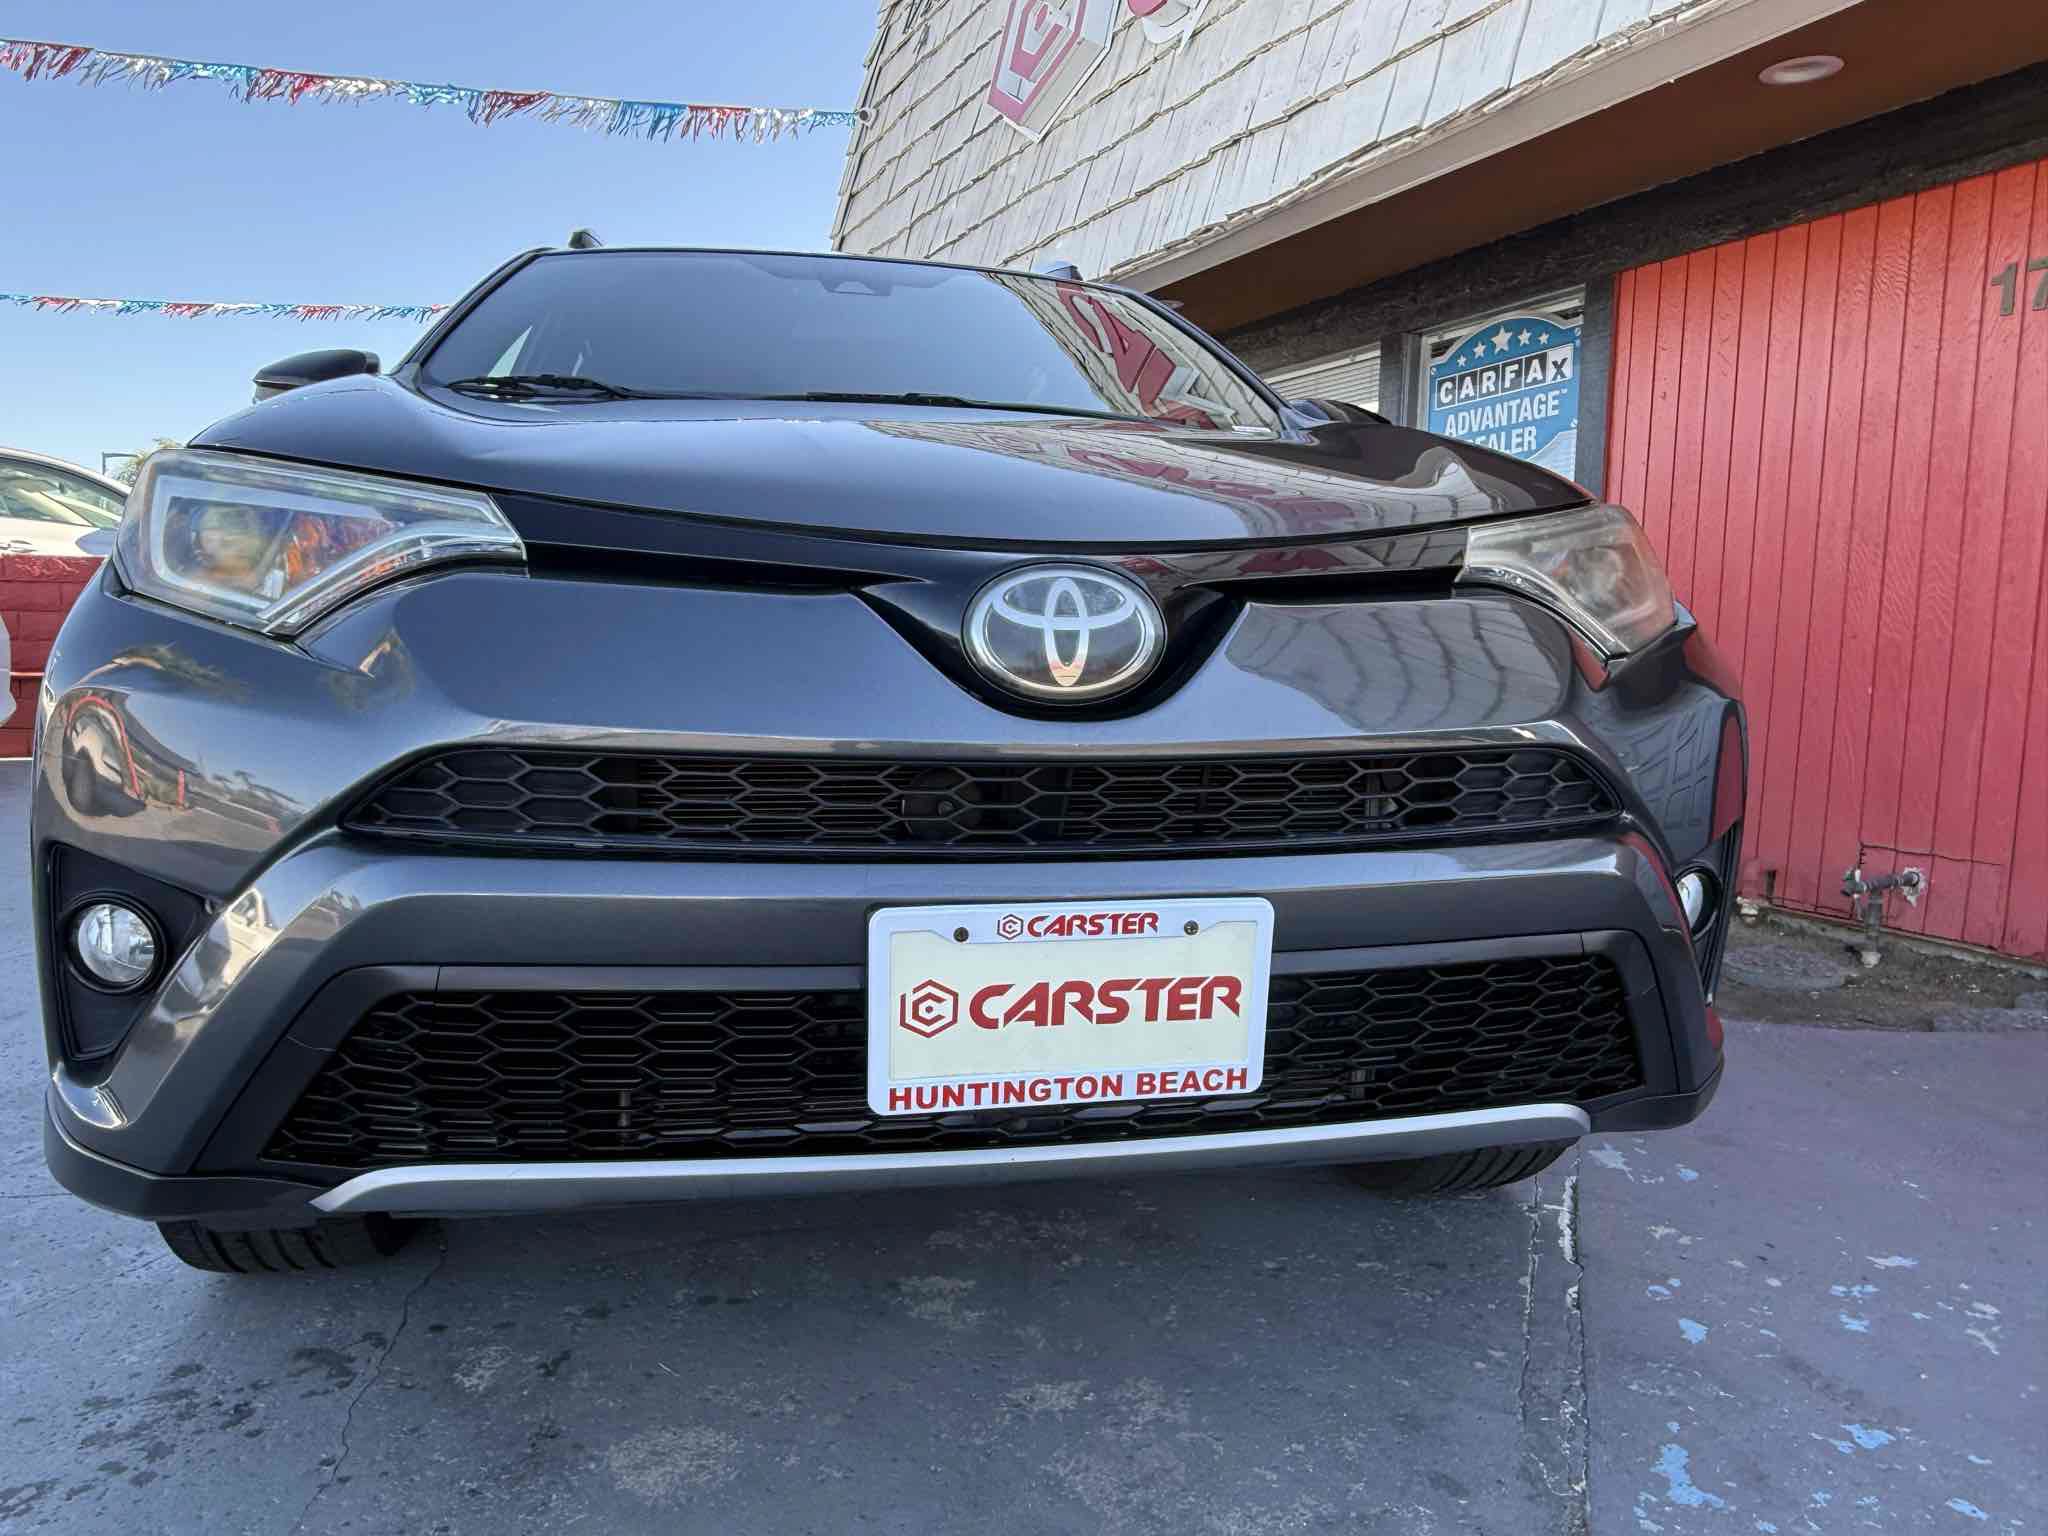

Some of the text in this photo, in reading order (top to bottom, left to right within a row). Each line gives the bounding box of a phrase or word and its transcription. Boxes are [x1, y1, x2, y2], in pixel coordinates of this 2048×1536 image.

[1440, 357, 1569, 404] CARFAX
[1027, 912, 1159, 937] CARSTER
[968, 975, 1242, 1030] CARSTER
[888, 1067, 1248, 1111] HUNTINGTON BEACH
